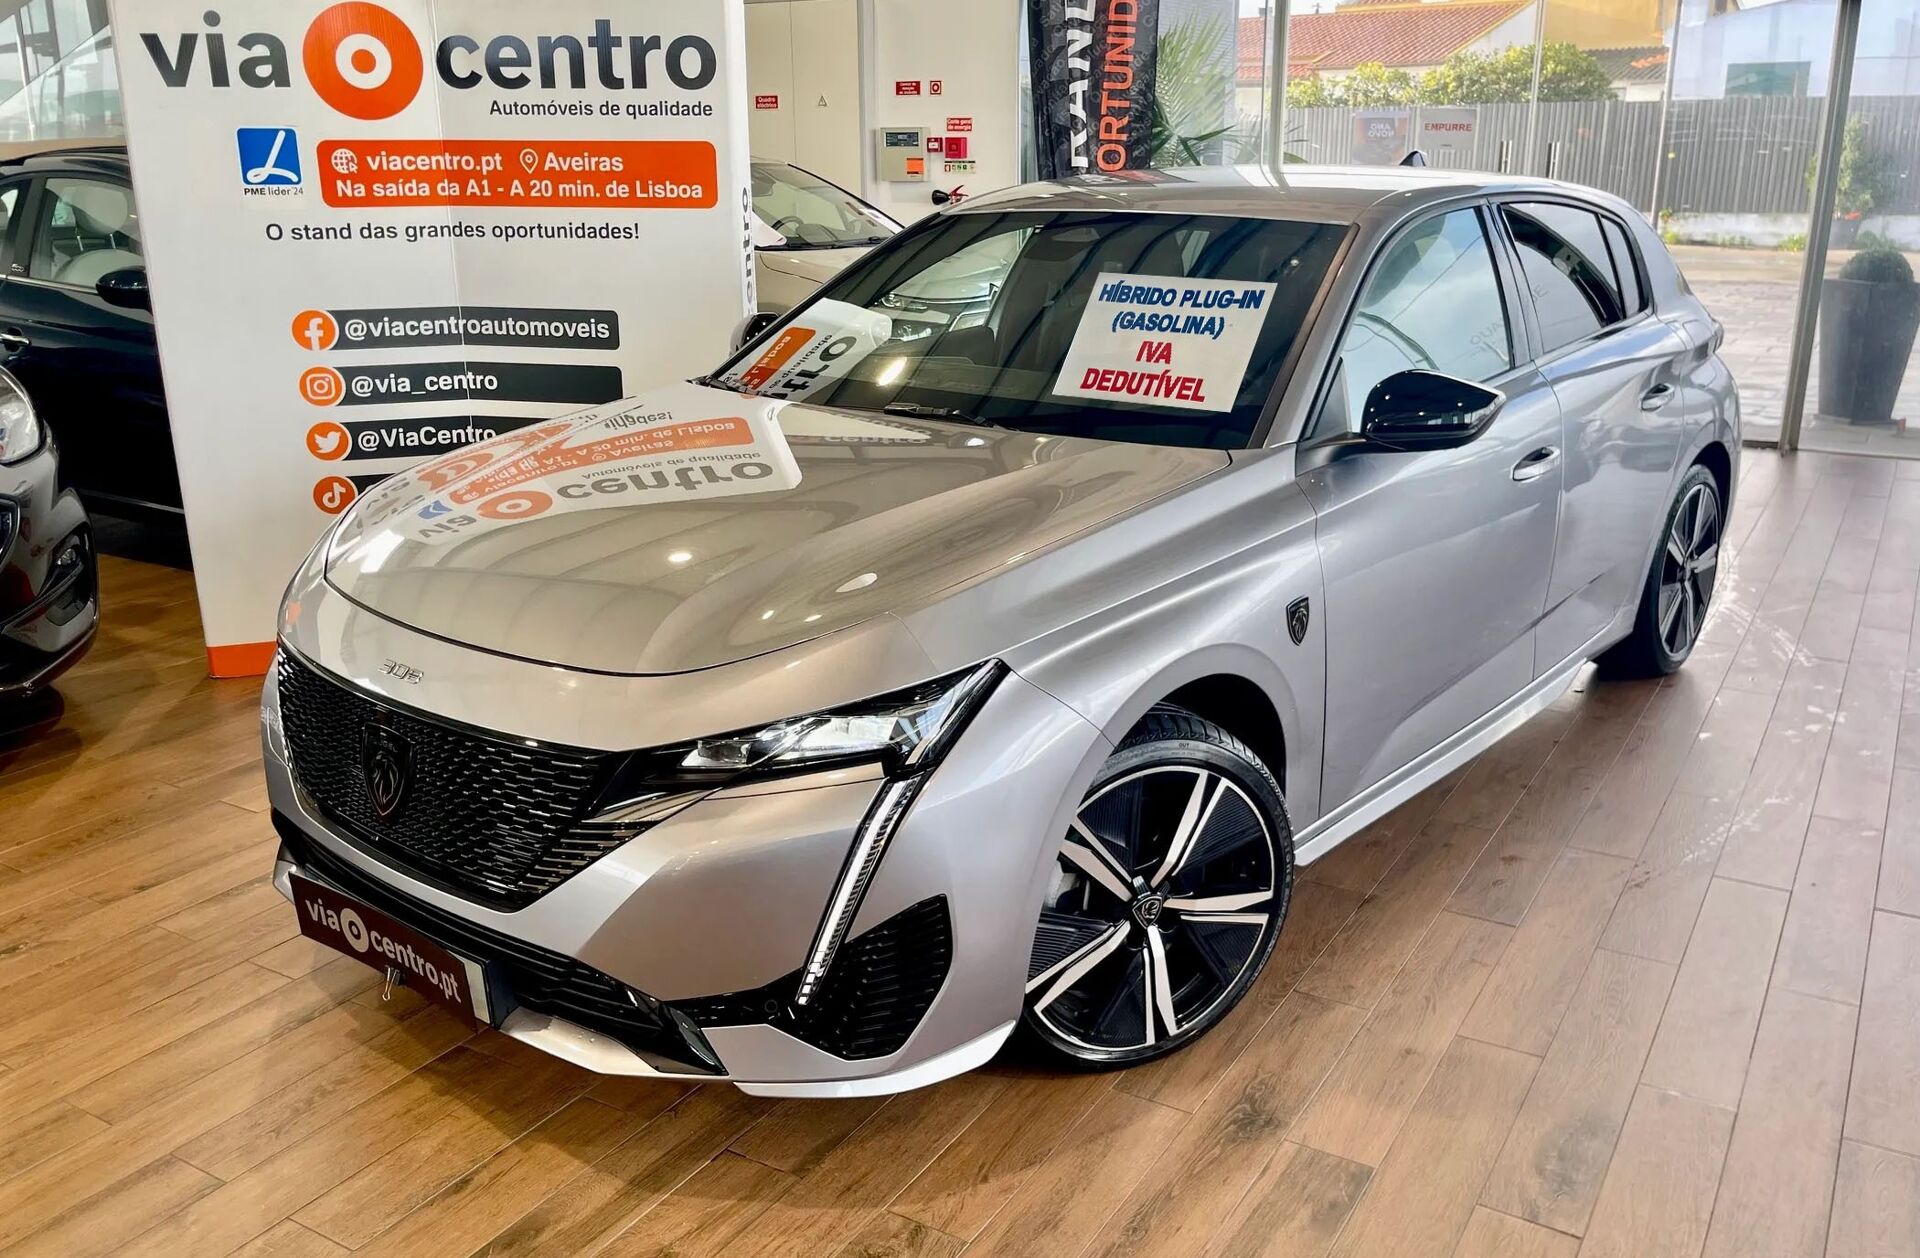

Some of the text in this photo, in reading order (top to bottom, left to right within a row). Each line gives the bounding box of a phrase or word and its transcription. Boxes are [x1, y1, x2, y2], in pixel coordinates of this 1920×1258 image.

[140, 10, 717, 90] via centro
[490, 99, 713, 119] Automóveis de qualidade
[1424, 122, 1473, 132] EMPURRE
[366, 151, 624, 175] viacentro.pt Aveiras
[243, 187, 266, 196] PME
[336, 179, 366, 198] Na
[372, 178, 431, 197] saída
[436, 179, 460, 197] da
[466, 179, 492, 197] A1
[509, 179, 525, 197] A
[529, 180, 553, 198] 20
[558, 181, 601, 198] min.
[605, 180, 630, 198] de
[635, 180, 704, 199] Lisboa
[266, 221, 640, 243] O stand das grandes oportunidades!
[1099, 280, 1266, 309] HÍBRIDO PLUG-IN
[344, 316, 610, 341] @viacentroautomoveis
[1112, 311, 1225, 339] (GASOLINA)
[1135, 341, 1173, 365] IVA
[351, 371, 499, 398] @via_centro
[1080, 368, 1206, 402] DEDUTÍVEL
[358, 426, 497, 452] @ViaCentro
[305, 898, 463, 1004] via centro.pt
